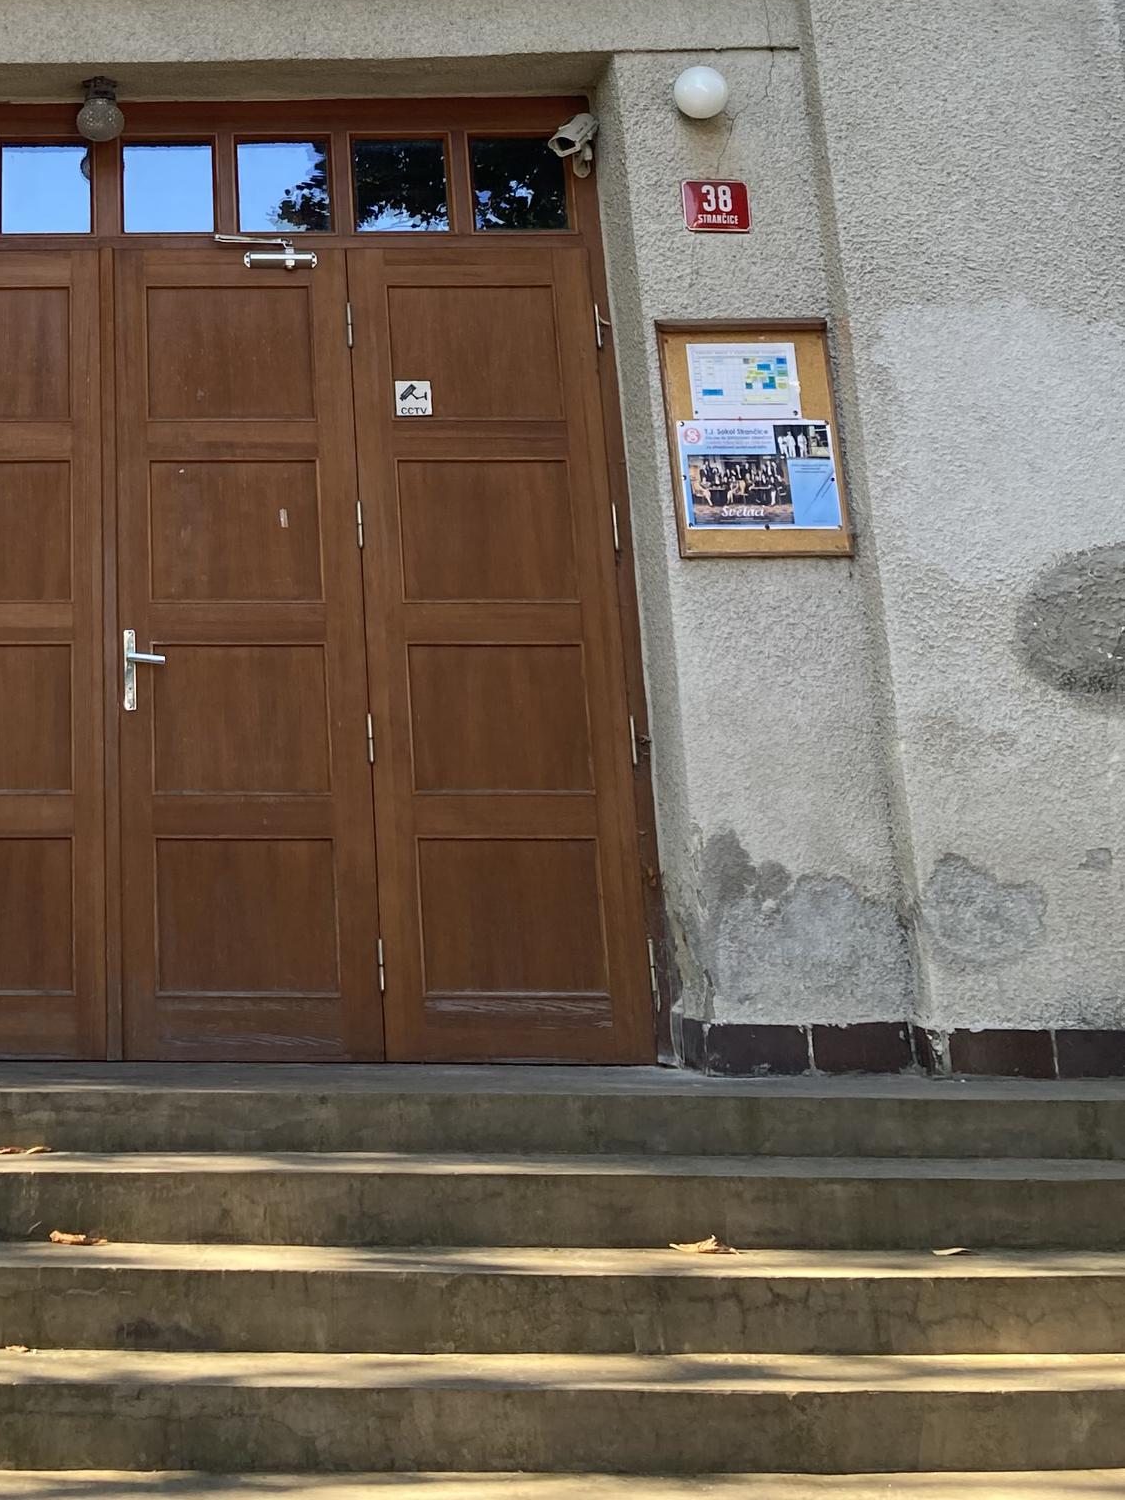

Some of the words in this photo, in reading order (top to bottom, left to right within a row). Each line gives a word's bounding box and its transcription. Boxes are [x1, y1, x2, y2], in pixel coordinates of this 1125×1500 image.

[701, 185, 733, 212] 38
[698, 213, 739, 224] STRANČICE
[401, 407, 427, 415] CCTV
